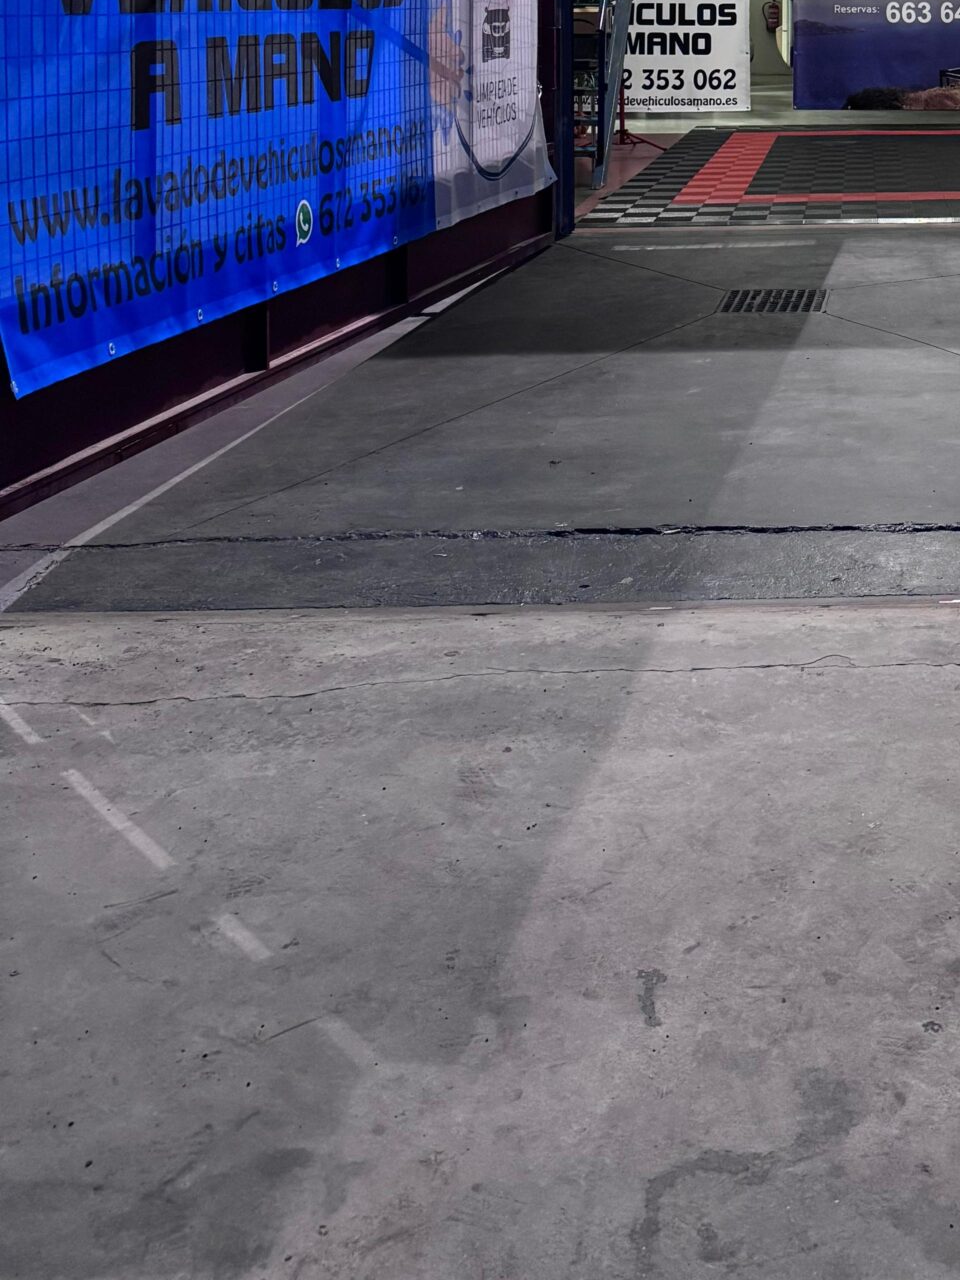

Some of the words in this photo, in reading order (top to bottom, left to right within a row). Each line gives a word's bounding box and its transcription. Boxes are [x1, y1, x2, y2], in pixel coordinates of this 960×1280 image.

[834, 4, 880, 14] Reservas:
[886, 1, 932, 24] 663
[131, 39, 181, 131] A
[207, 30, 375, 118] MANO
[641, 69, 685, 90] 353
[693, 69, 737, 90] 062
[14, 228, 204, 334] Información
[213, 231, 228, 272] y
[234, 212, 287, 264] citas
[360, 176, 398, 222] 353
